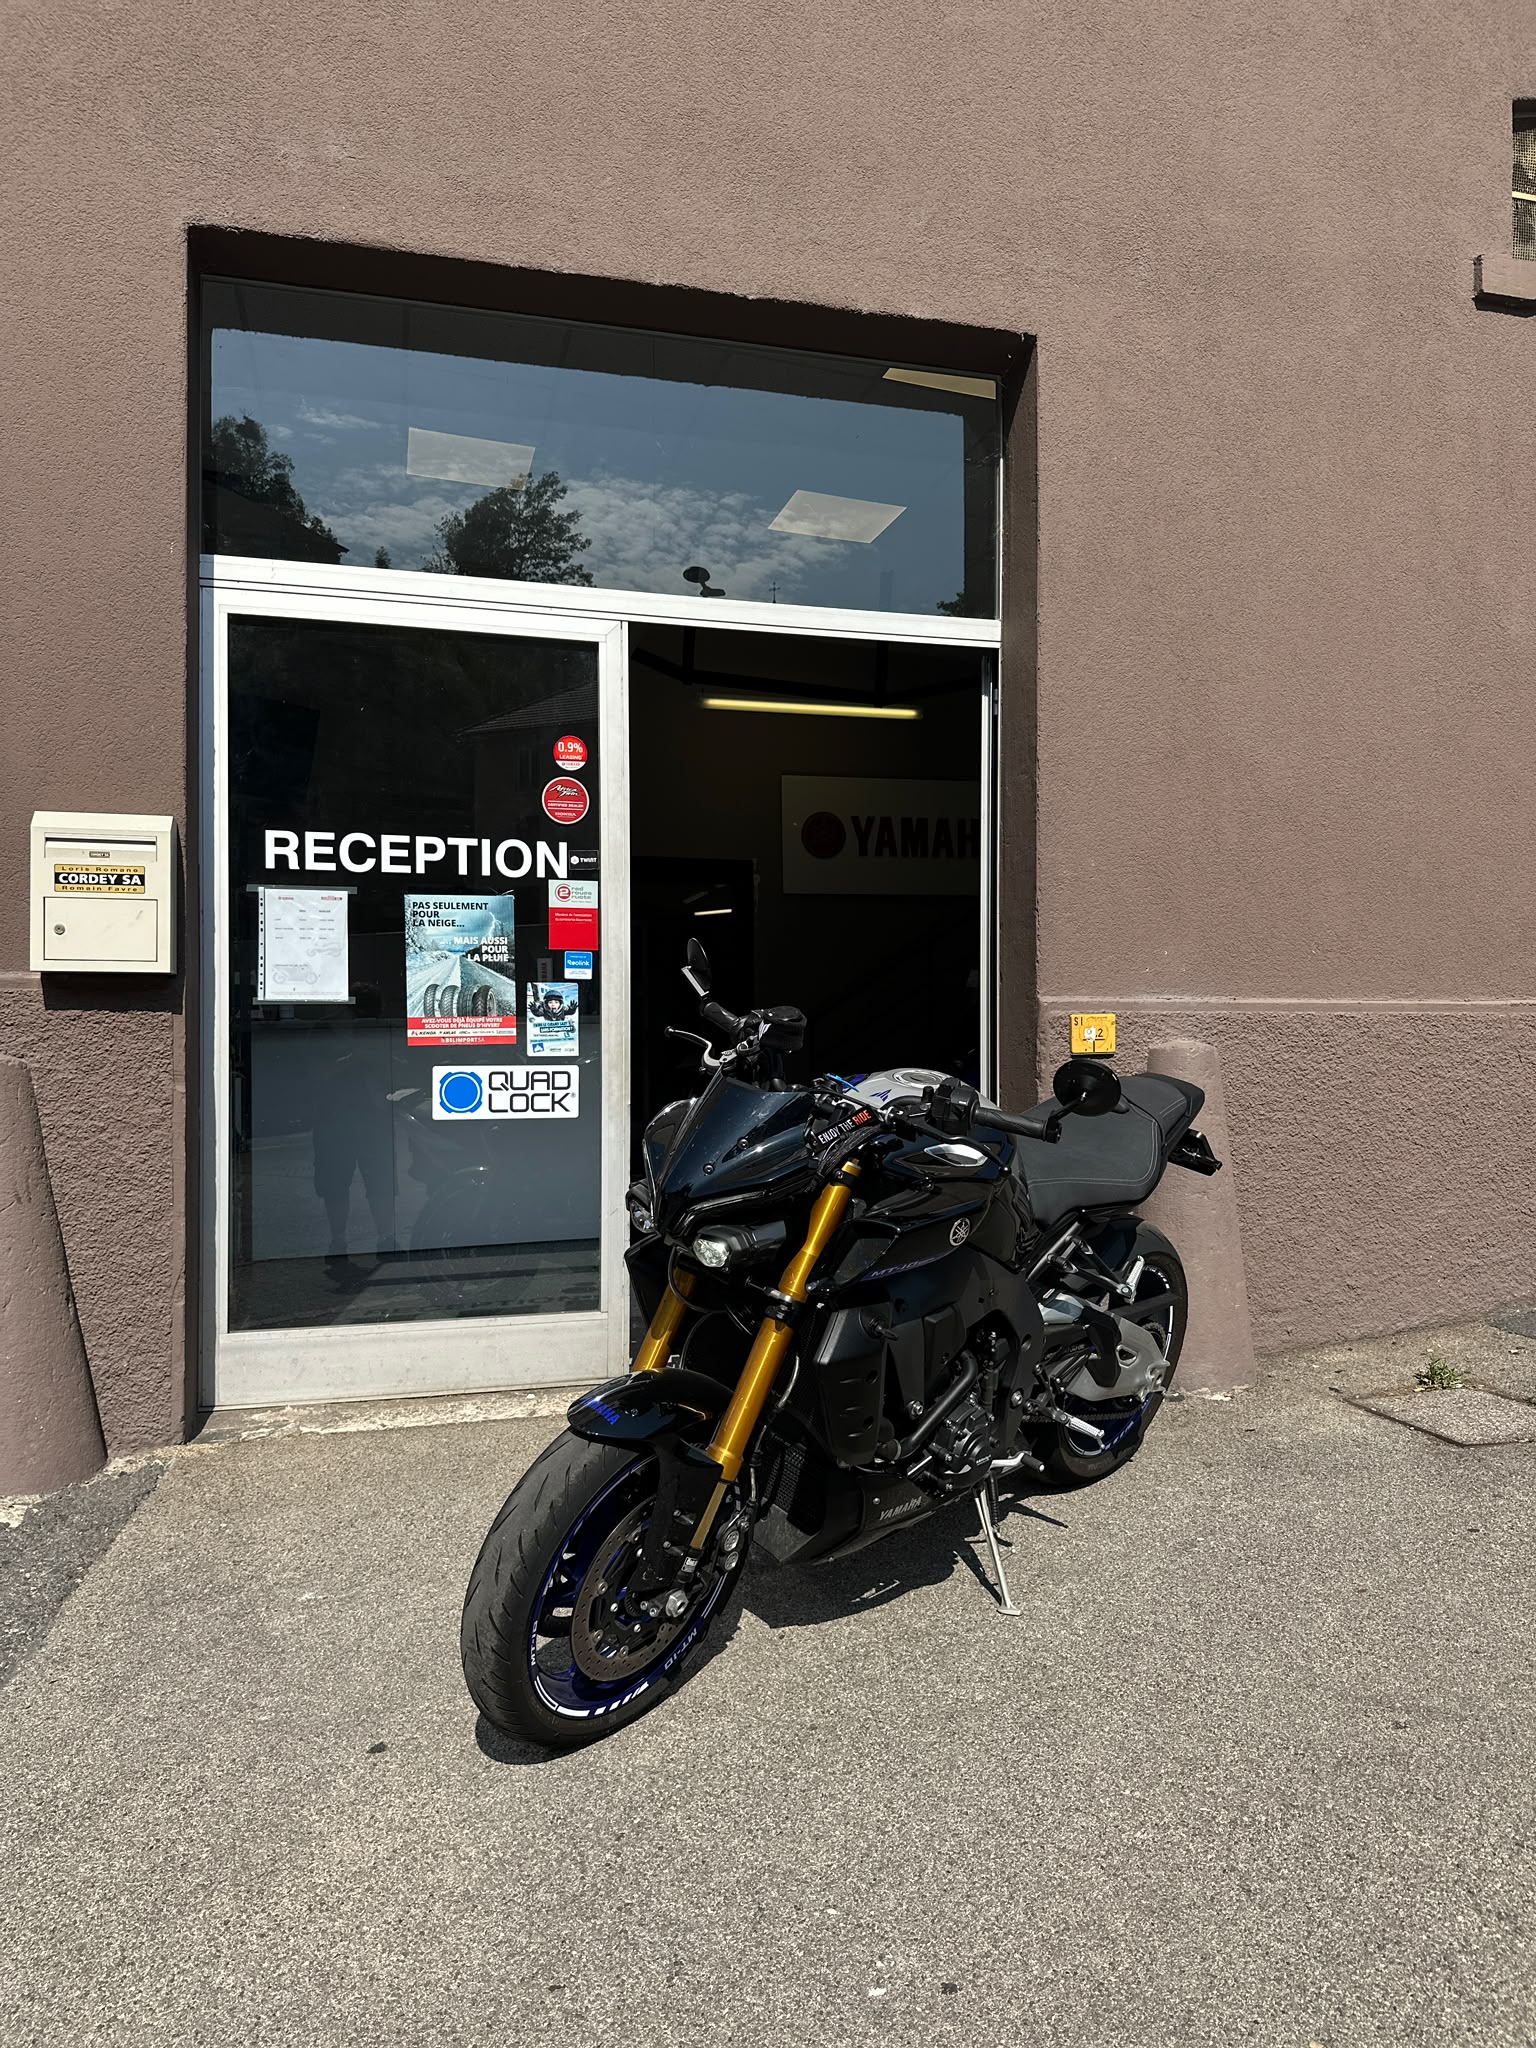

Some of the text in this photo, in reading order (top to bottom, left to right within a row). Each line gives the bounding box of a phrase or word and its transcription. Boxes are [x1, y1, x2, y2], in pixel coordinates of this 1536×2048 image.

[557, 741, 583, 753] 0.9%
[264, 829, 568, 879] RECEPTION
[58, 873, 142, 885] CORDEY SA
[412, 901, 489, 911] PAS SEULEMENT
[412, 910, 440, 919] POUR
[412, 919, 465, 928] LA NEIGE...
[481, 936, 508, 945] AUSSI
[481, 945, 509, 954] POUR
[467, 953, 509, 962] LA PLUIE
[488, 1071, 571, 1092] QUAD
[817, 1109, 872, 1145] ENJOY THE RIDE
[879, 1495, 922, 1521] YAMAHA
[530, 1620, 539, 1666] MT-10
[664, 1627, 698, 1671] MT-10
